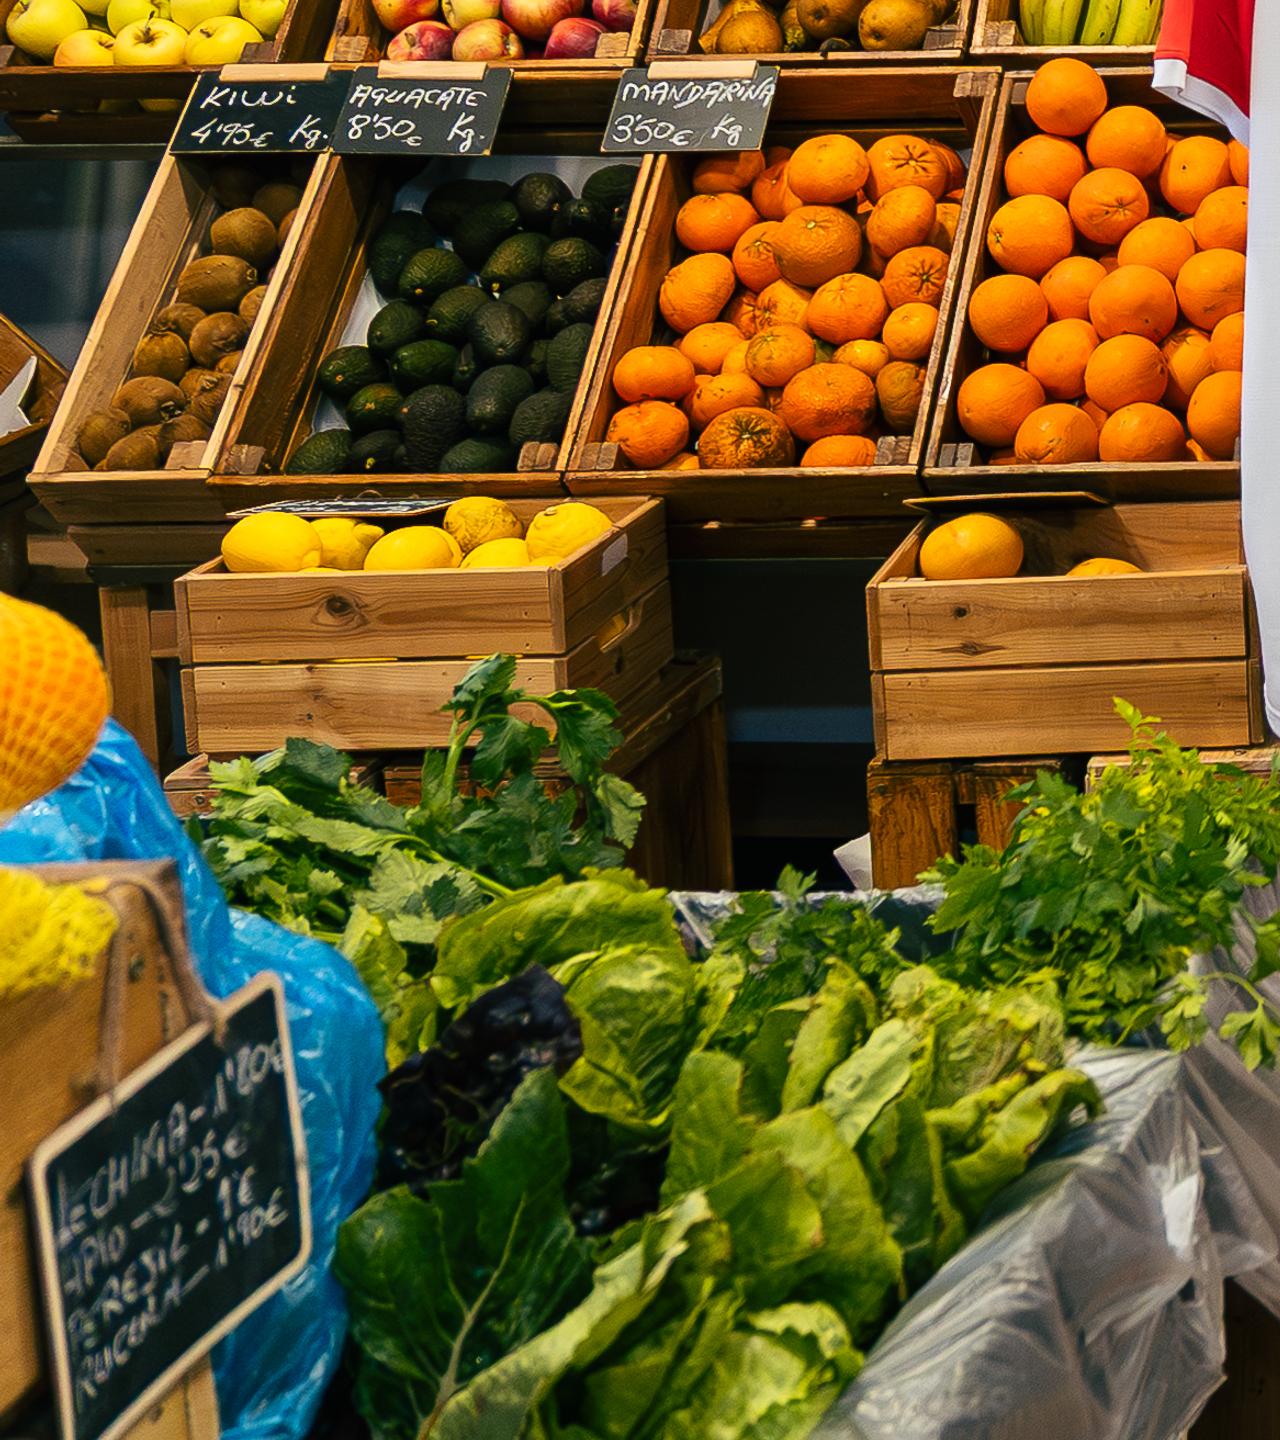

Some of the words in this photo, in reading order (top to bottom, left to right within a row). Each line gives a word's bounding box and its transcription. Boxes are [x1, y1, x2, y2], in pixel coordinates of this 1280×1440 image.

[348, 84, 489, 111] AGUACATE
[190, 122, 274, 149] 4'95€
[347, 115, 424, 147] 8'50€
[612, 119, 695, 151] 3'50€
